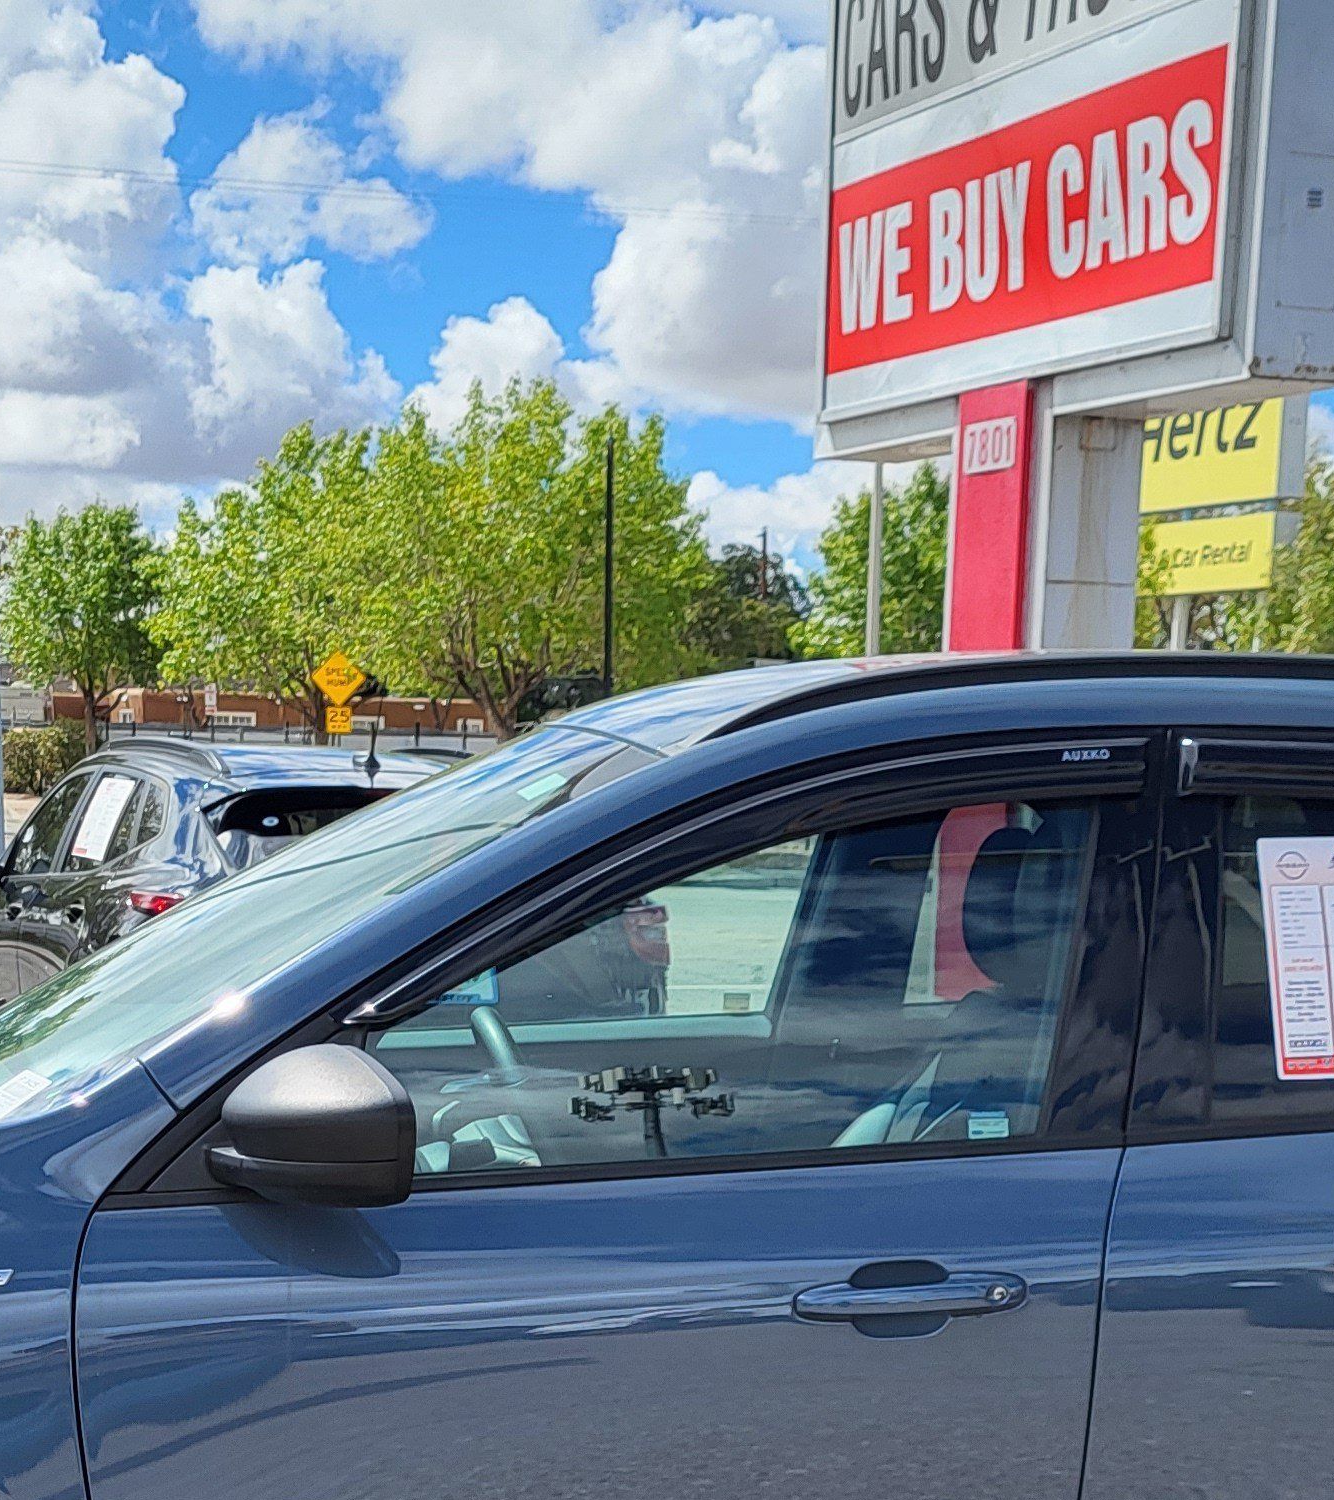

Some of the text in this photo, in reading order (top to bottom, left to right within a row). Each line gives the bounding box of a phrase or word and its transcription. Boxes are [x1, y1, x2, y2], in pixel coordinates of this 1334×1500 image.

[844, 0, 946, 117] CARS
[839, 99, 1214, 335] WE BUY CARS
[968, 425, 1012, 468] 7801
[330, 710, 349, 723] 25
